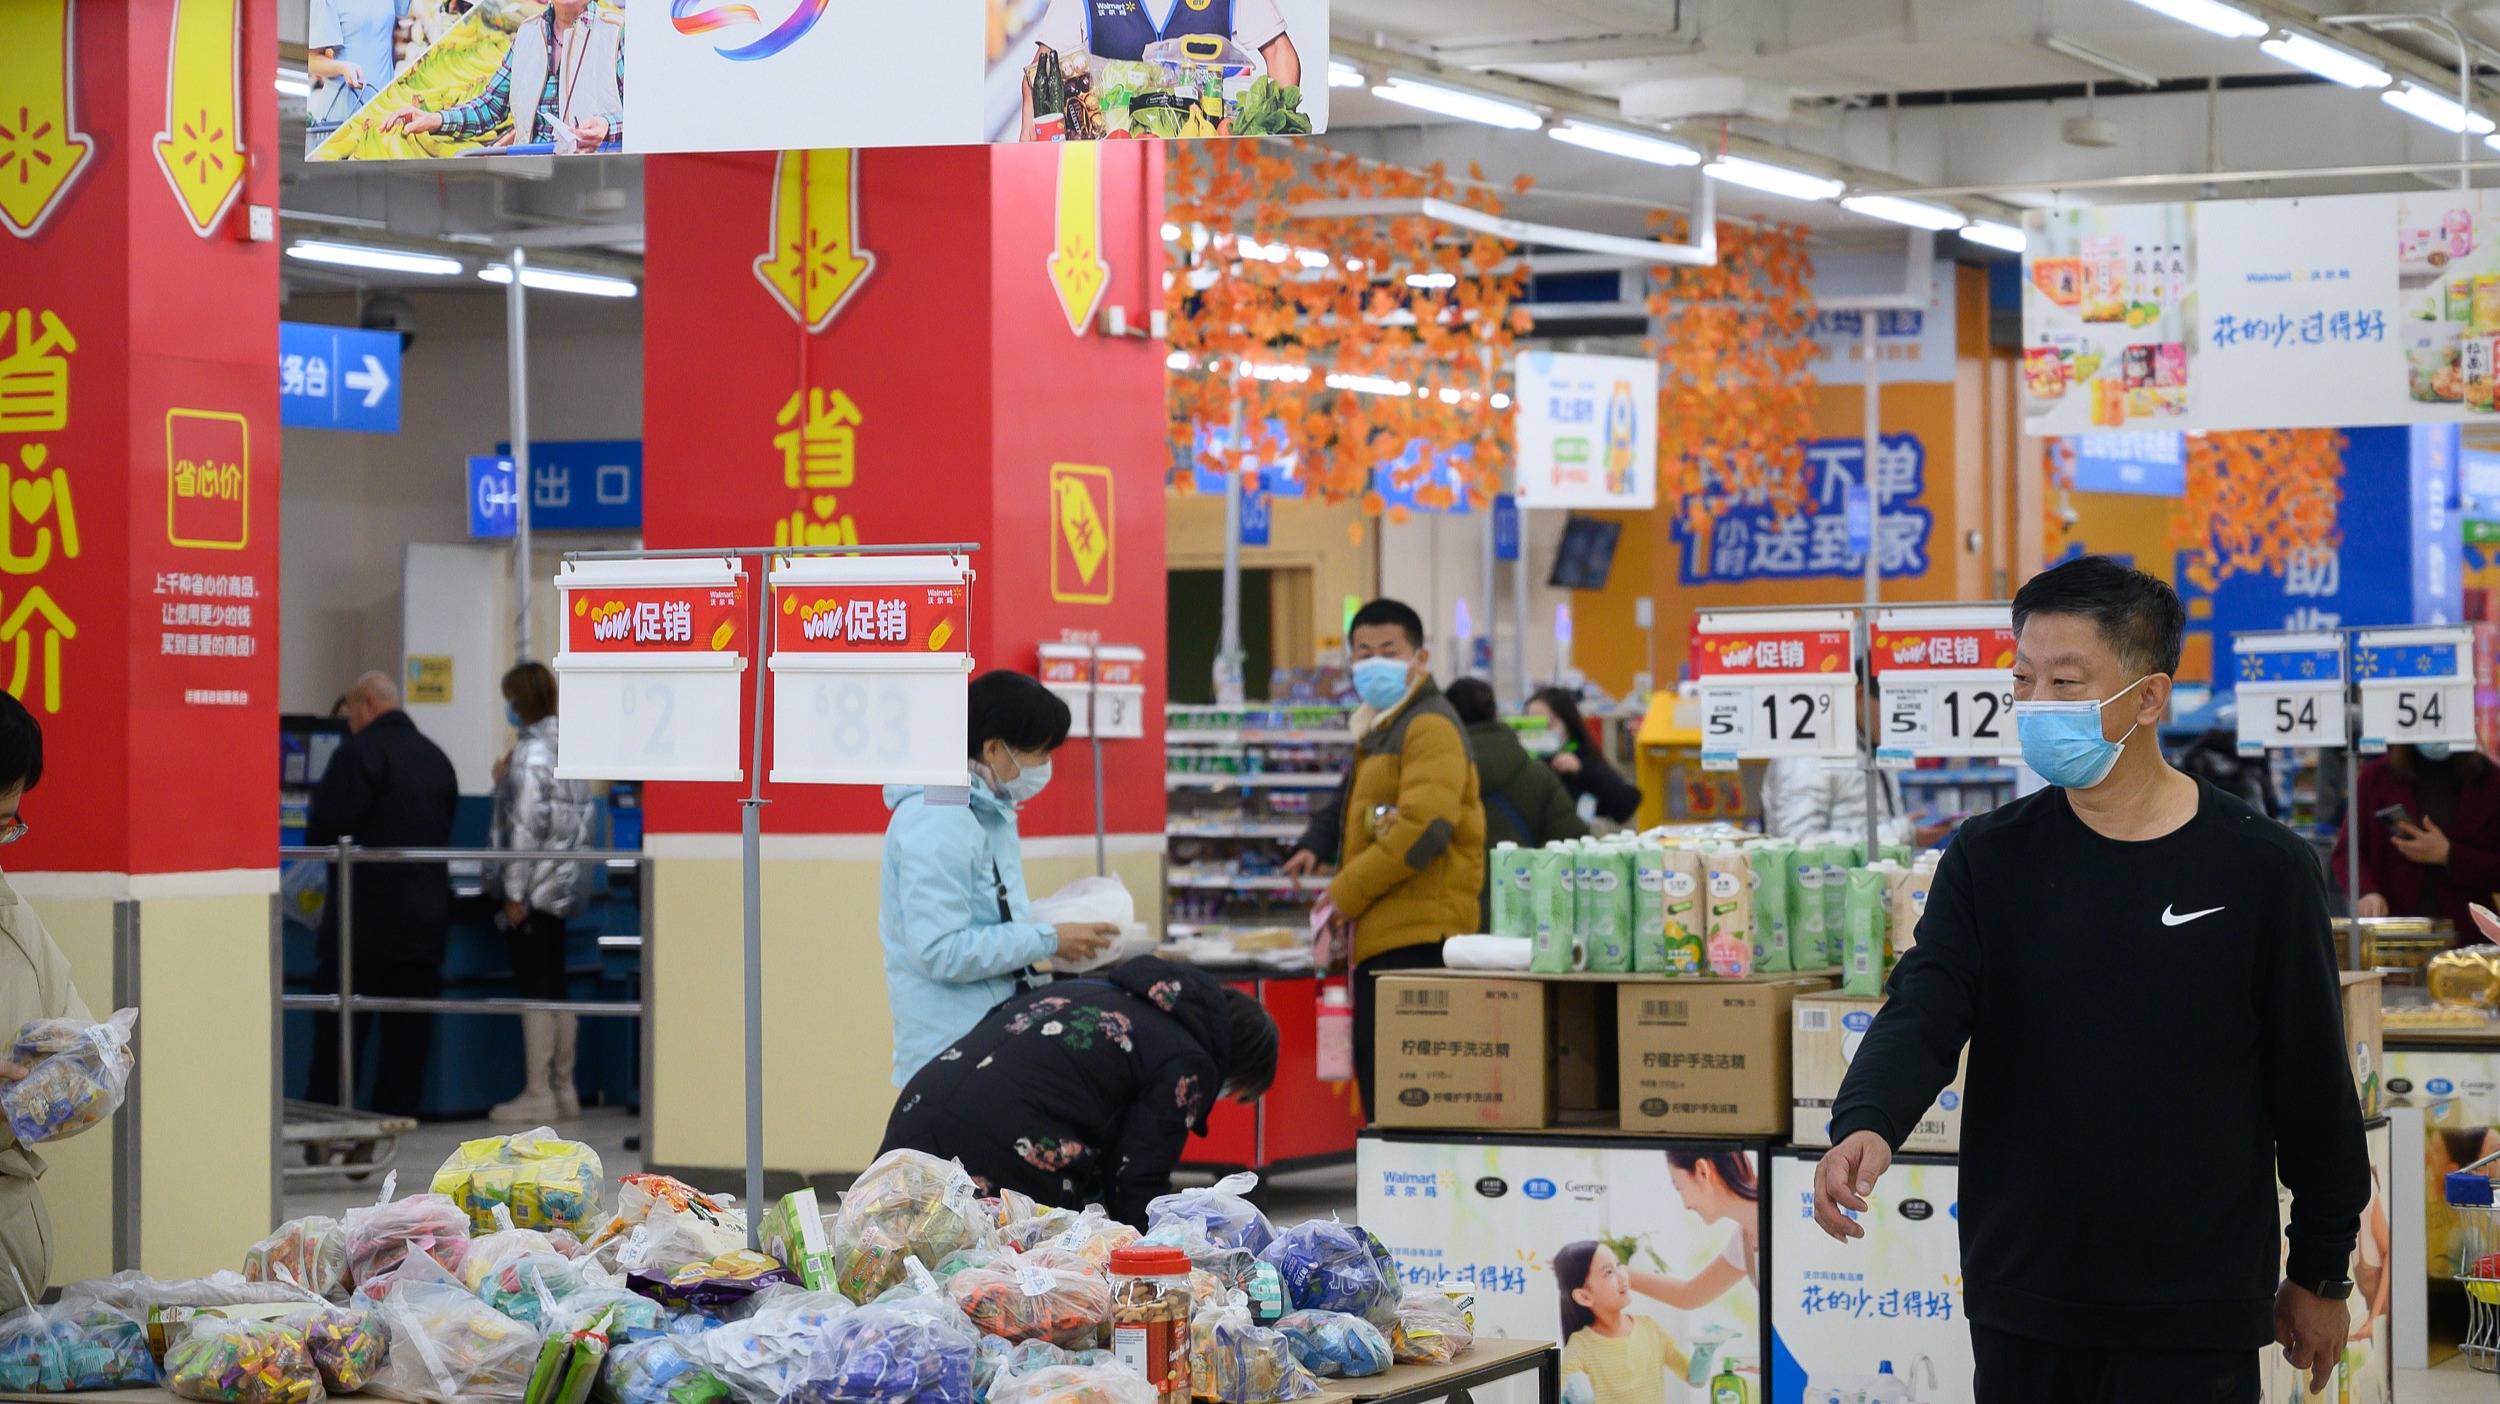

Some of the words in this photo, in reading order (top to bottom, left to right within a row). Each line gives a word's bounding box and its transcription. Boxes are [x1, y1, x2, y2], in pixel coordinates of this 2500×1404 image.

[279, 353, 328, 397] 务台
[175, 459, 242, 501] 省心价
[535, 464, 631, 507] 出口
[709, 590, 734, 599] Walmart
[927, 588, 953, 598] Walmart
[162, 603, 251, 628] 让您用更少的钱
[633, 600, 692, 642] 促销
[845, 599, 907, 641] 促销
[1755, 640, 1805, 669] 促销
[1928, 637, 1979, 665] 促销
[2275, 697, 2317, 733] 54
[2397, 692, 2443, 728] 54
[1401, 1039, 1511, 1058] 柠檬护手洗洁精
[1643, 1052, 1746, 1070] 柠檬护手洗洁精
[1383, 1170, 1437, 1185] Walmart
[1565, 1180, 1608, 1195] George
[1384, 1185, 1438, 1199] 沃尔玛
